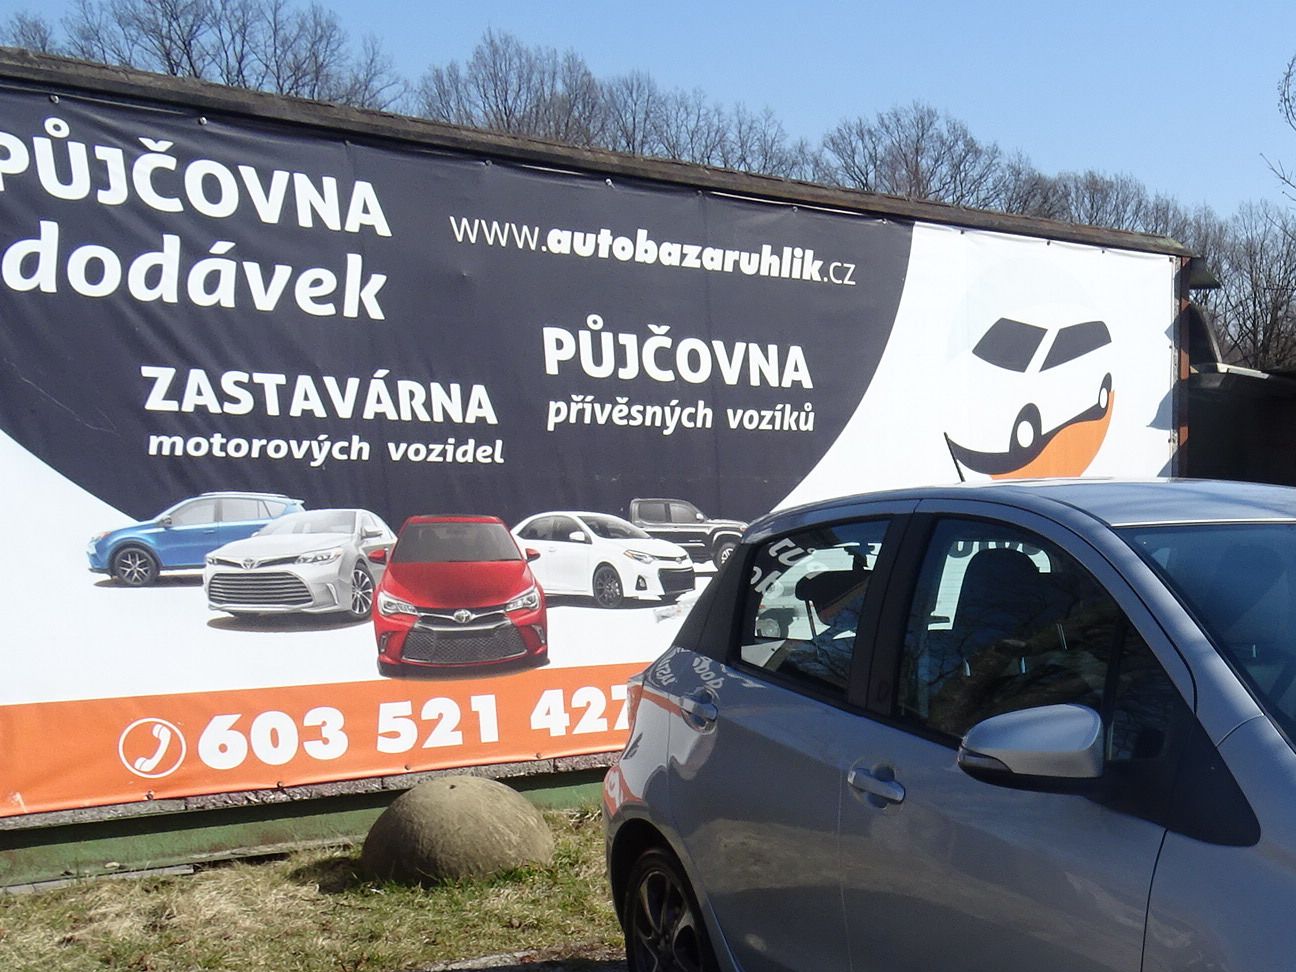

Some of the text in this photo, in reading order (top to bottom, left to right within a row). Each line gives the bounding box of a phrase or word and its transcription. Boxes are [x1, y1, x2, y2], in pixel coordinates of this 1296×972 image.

[0, 117, 392, 237] PŮJČOVNA
[2, 220, 387, 320] dodávek
[450, 216, 856, 286] www.autobazaruhlik.cz
[542, 314, 814, 389] PŮJČOVNA
[141, 366, 498, 424] ZASTAVÁRNA
[547, 395, 815, 435] přívěsných vozíků
[148, 432, 505, 467] motorových vozidel
[198, 713, 349, 770] 603
[377, 697, 500, 755] 521
